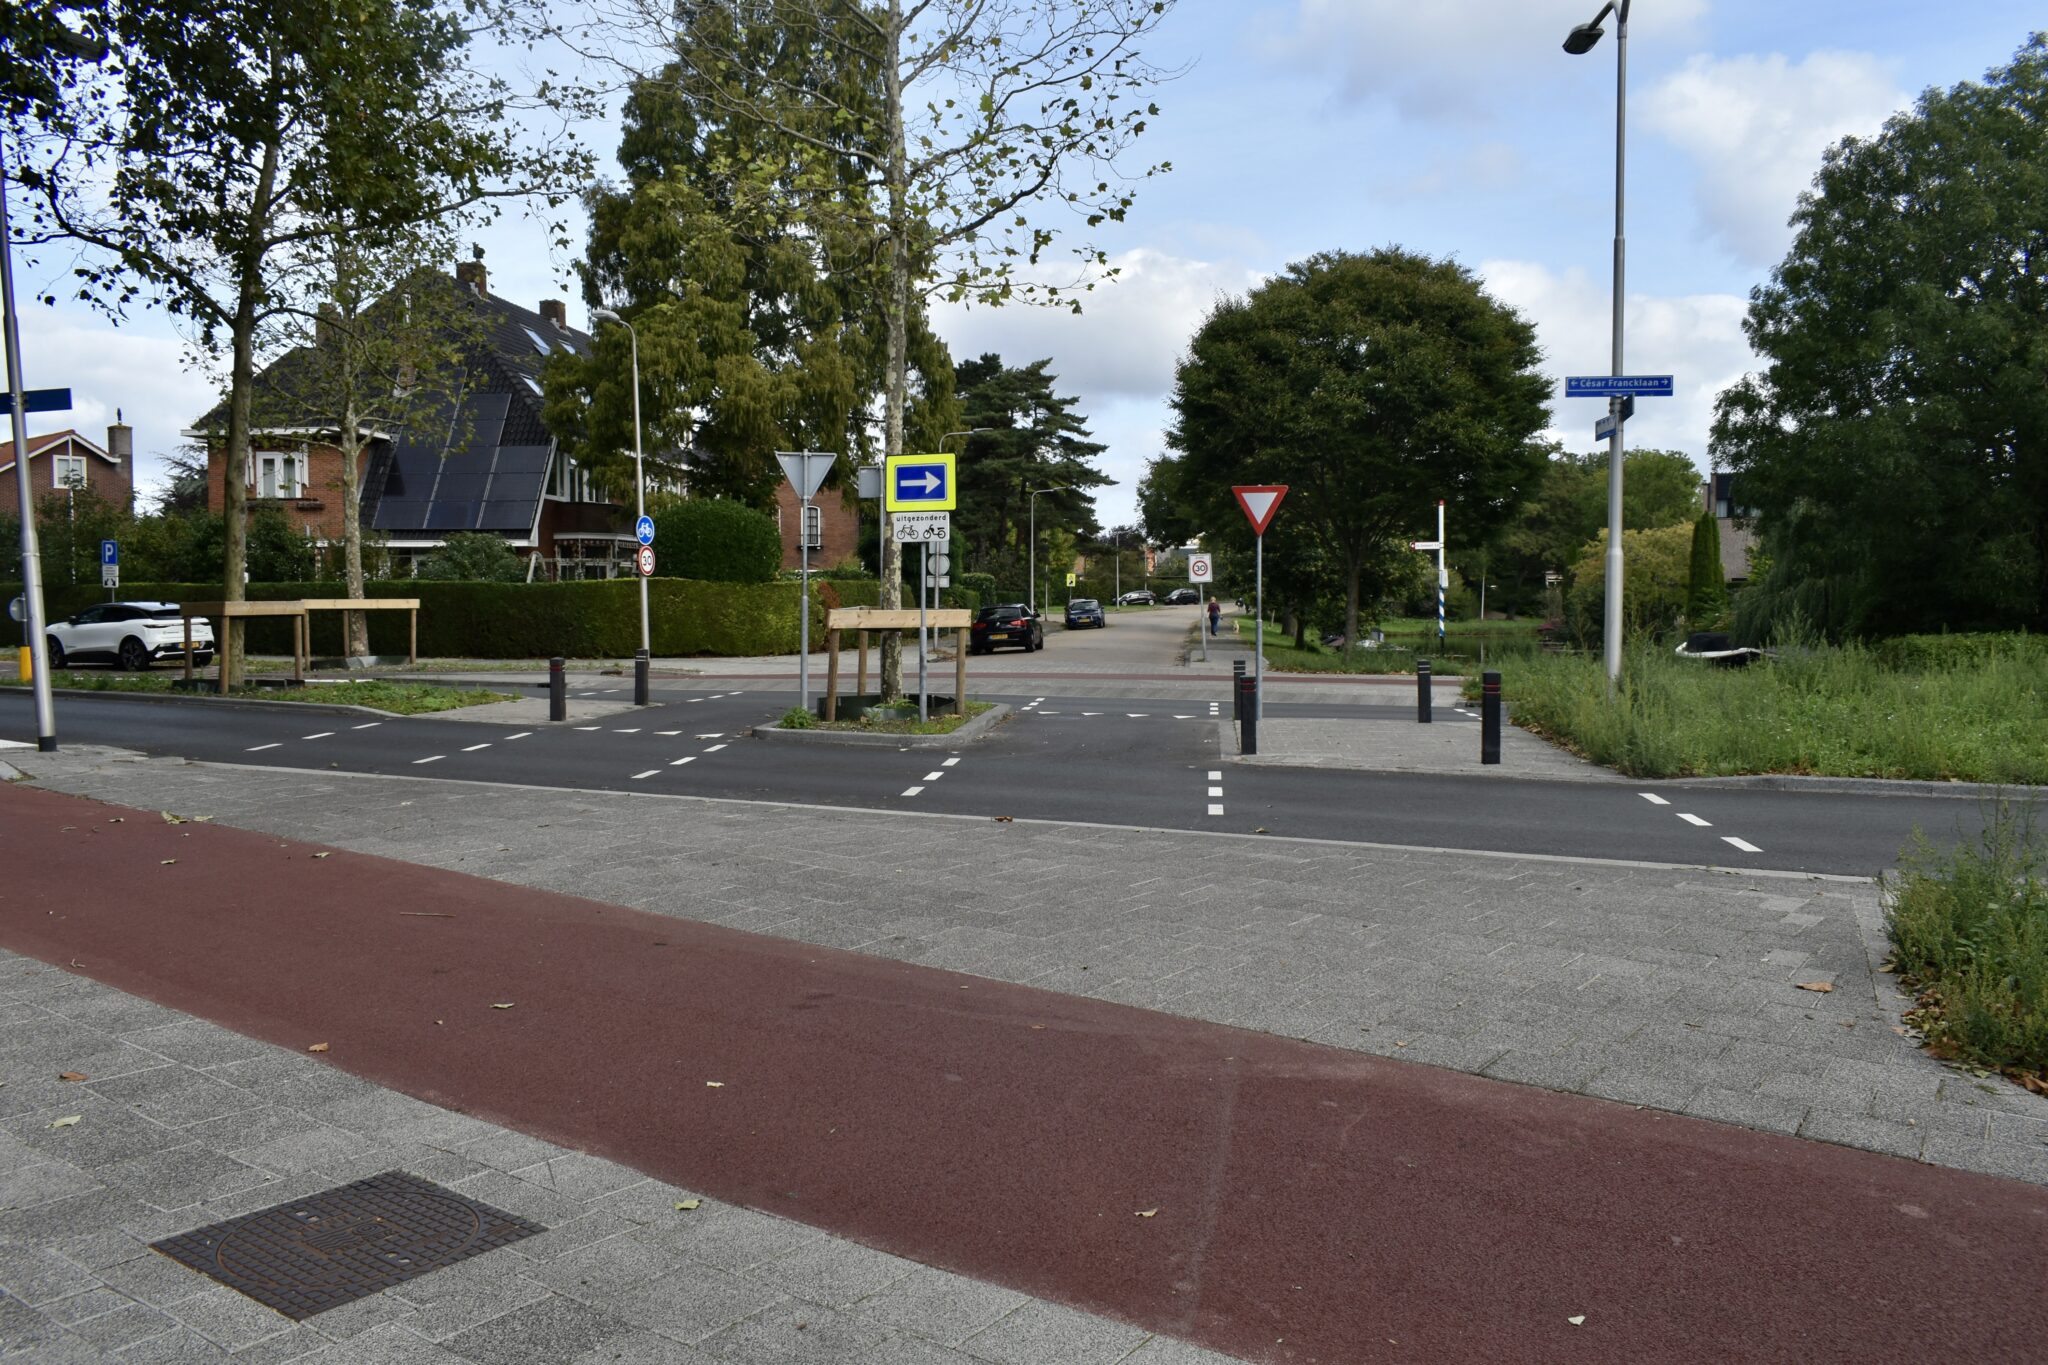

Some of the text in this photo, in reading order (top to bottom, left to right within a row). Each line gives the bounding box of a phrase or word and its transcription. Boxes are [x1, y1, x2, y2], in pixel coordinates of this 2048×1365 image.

[1580, 379, 1659, 388] César Francklaan
[896, 514, 946, 523] uitgezonderd
[105, 543, 114, 562] P
[643, 555, 652, 566] 30
[1195, 564, 1206, 572] 30
